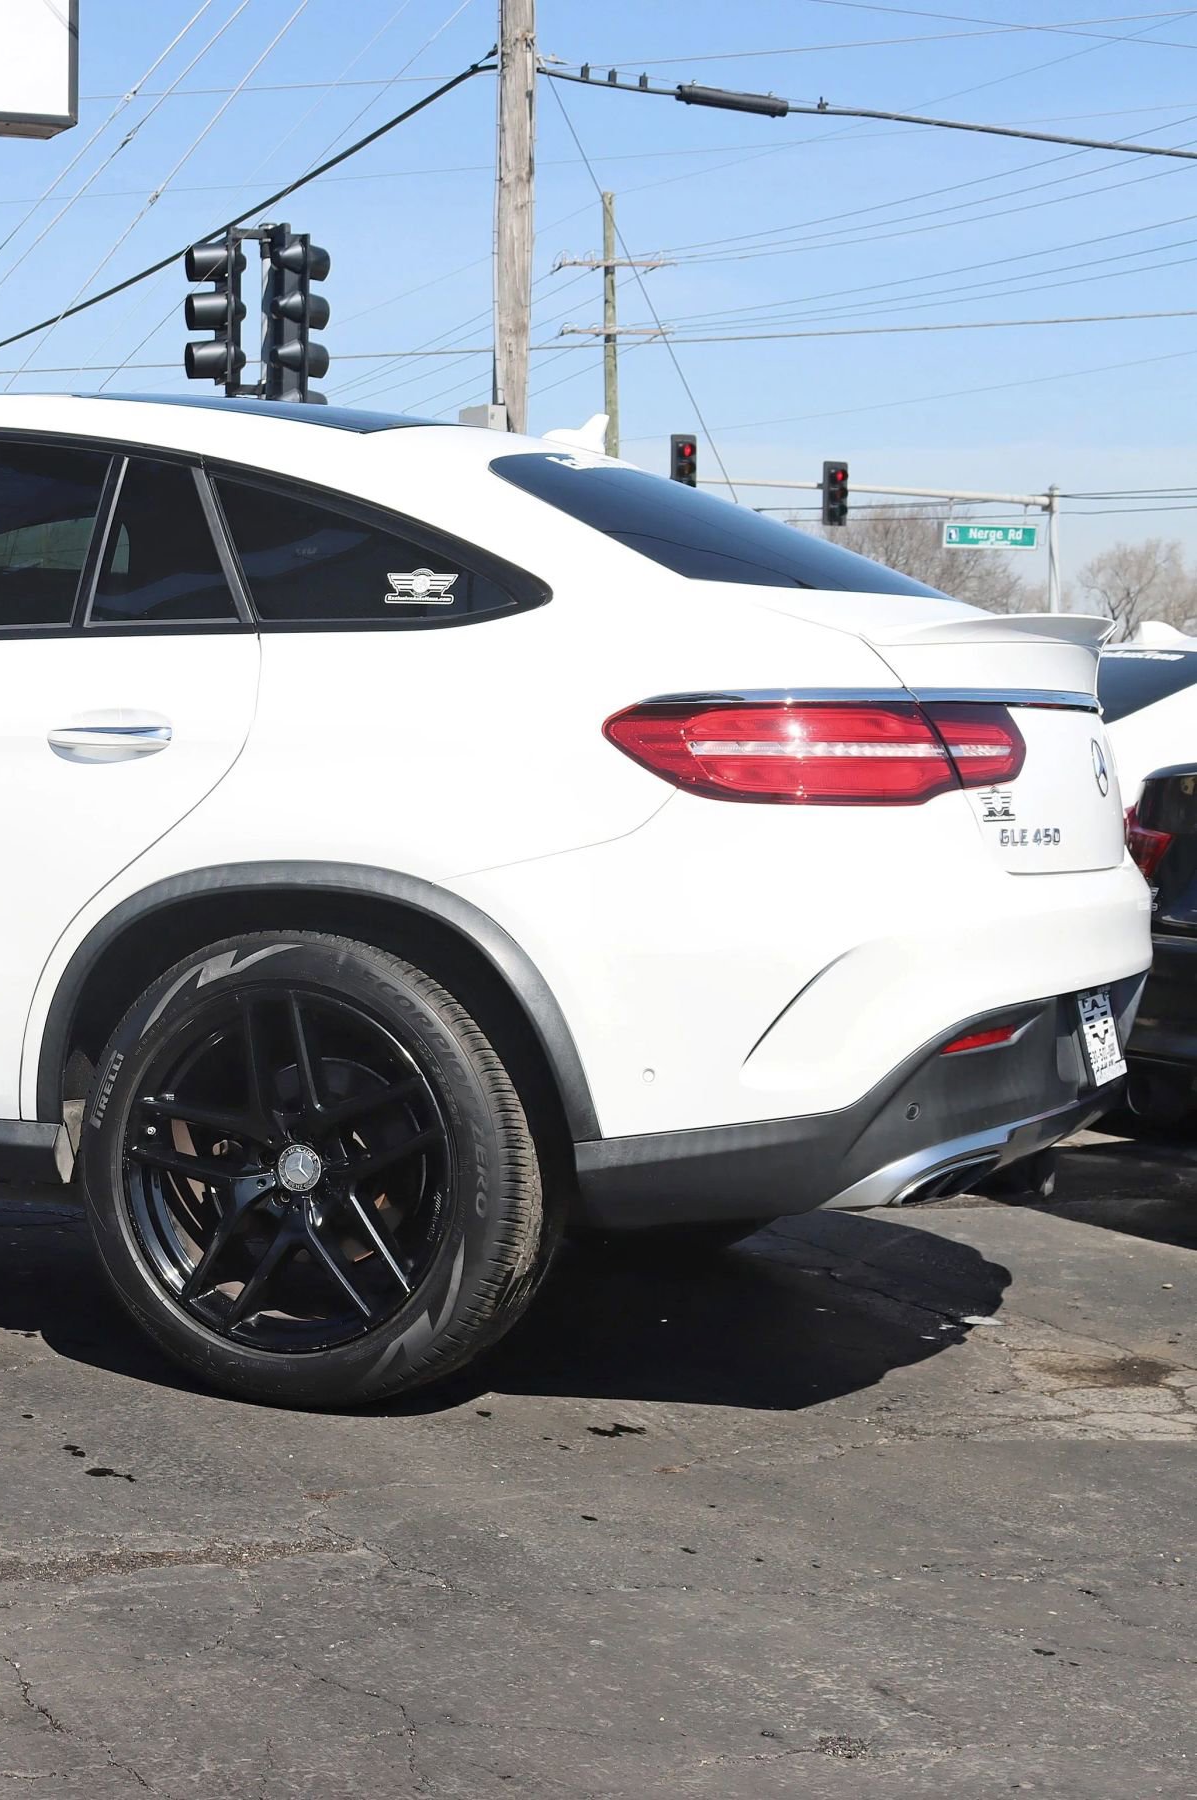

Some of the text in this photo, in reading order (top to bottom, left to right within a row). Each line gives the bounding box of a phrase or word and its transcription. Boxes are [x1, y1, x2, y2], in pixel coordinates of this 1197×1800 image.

[968, 527, 1023, 542] Nerge Rd
[999, 827, 1061, 846] GLE 450
[89, 1049, 125, 1129] PIRELLI
